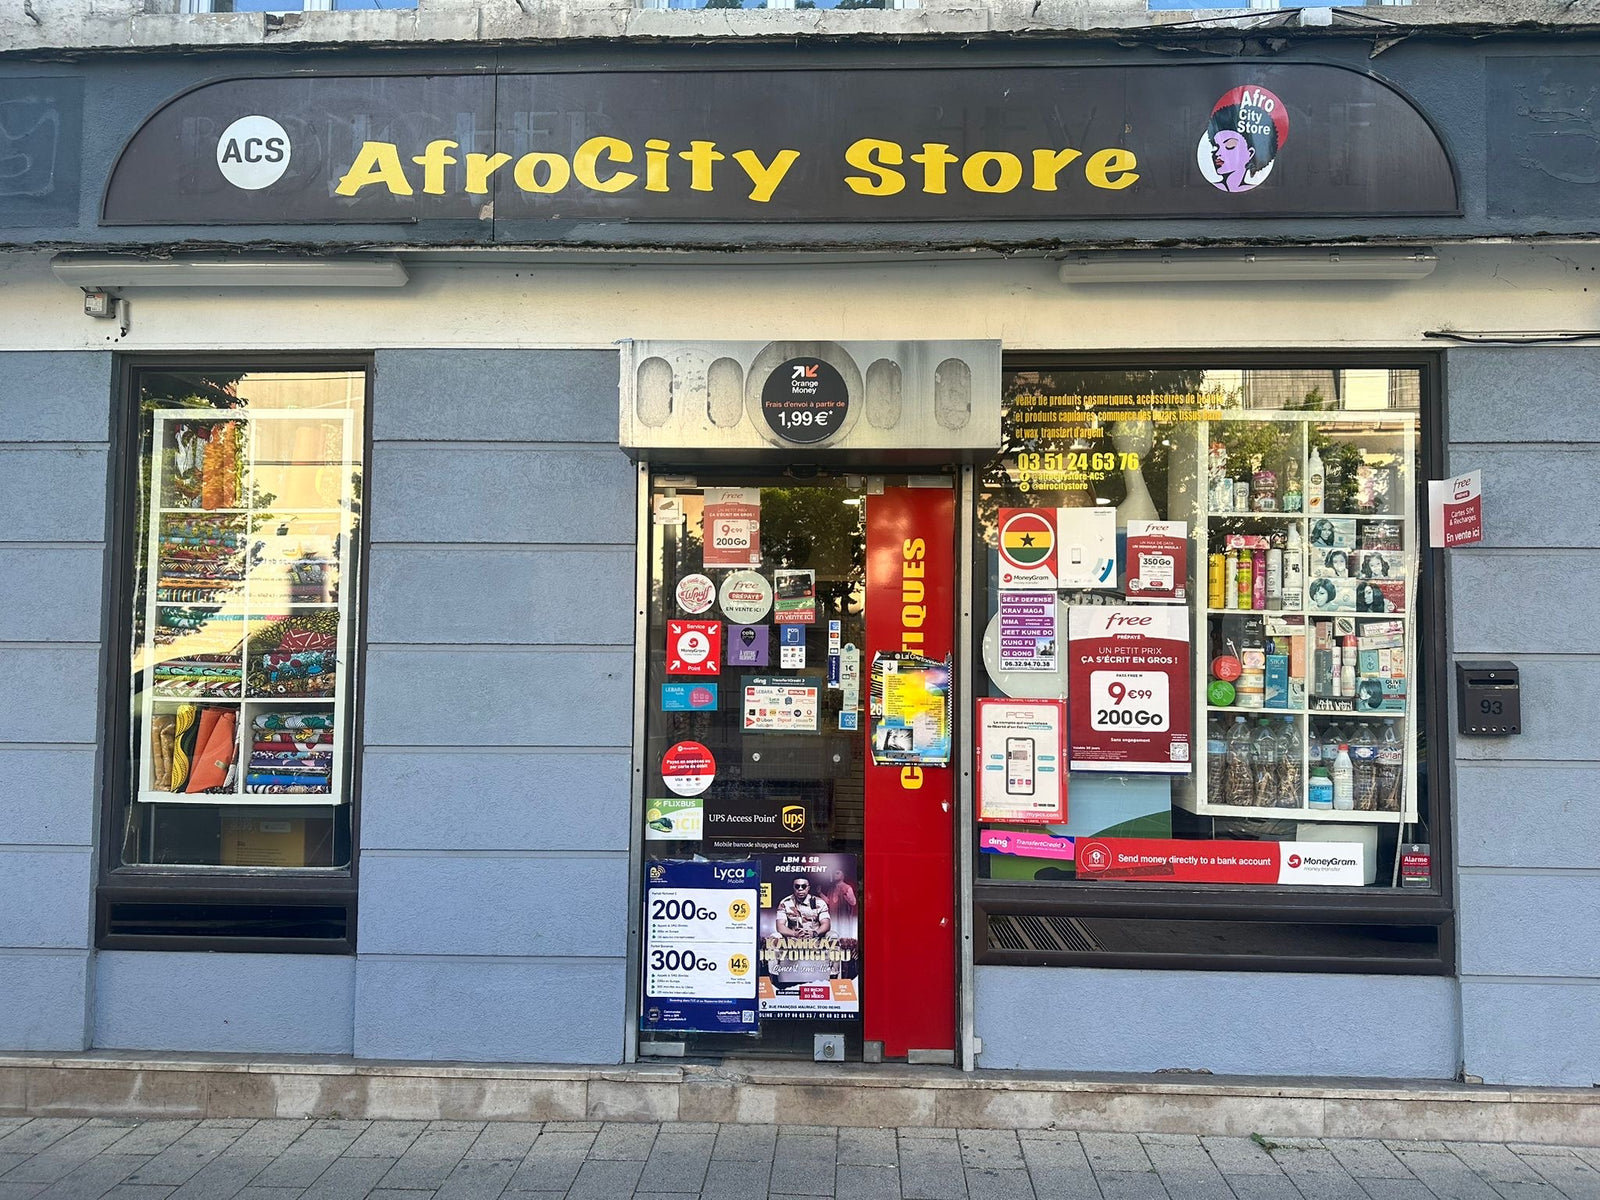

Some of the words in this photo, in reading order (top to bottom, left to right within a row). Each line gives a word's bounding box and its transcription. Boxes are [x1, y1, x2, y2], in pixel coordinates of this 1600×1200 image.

[1240, 88, 1275, 113] Afro
[1239, 109, 1262, 124] City
[1237, 120, 1271, 135] Store
[222, 137, 285, 164] ACS
[334, 135, 800, 203] AfroCity
[843, 137, 1139, 197] Store
[791, 380, 818, 389] Orange
[791, 387, 817, 395] Money
[815, 401, 834, 409] partir
[1038, 394, 1048, 405] de
[1049, 394, 1082, 407] produits
[1185, 392, 1195, 405] de
[1015, 410, 1023, 422] et
[1025, 410, 1057, 423] produits
[1138, 410, 1151, 421] des
[1015, 428, 1023, 438] et
[1041, 427, 1073, 438] transfert
[1018, 453, 1040, 471] 03
[1044, 453, 1063, 471] 51
[1066, 453, 1089, 471] 24
[1092, 452, 1115, 471] 63
[1118, 452, 1139, 471] 76
[1453, 478, 1471, 493] free
[721, 491, 744, 501] free
[1451, 509, 1465, 518] Cartes
[1466, 507, 1475, 515] SIM
[1454, 514, 1476, 525] Recharges
[1145, 523, 1169, 532] free
[1446, 533, 1454, 542] En
[1455, 530, 1472, 540] vente
[1472, 527, 1480, 537] ici
[733, 581, 759, 590] free
[1105, 612, 1152, 629] free
[901, 537, 926, 789] CTIQUES
[1081, 656, 1094, 665] ÇA
[1096, 655, 1130, 664] S'ÉCRIT
[870, 703, 882, 716] 26
[1480, 699, 1503, 715] 93
[709, 814, 725, 822] UPS
[784, 814, 803, 828] ups
[988, 837, 1008, 848] ding
[1118, 854, 1138, 863] Send
[1140, 856, 1167, 864] money
[1169, 855, 1198, 865] directly
[1217, 856, 1237, 864] bank
[1239, 858, 1271, 866] account
[714, 867, 745, 880] Lyca
[775, 864, 827, 873] PRÉSENTENT
